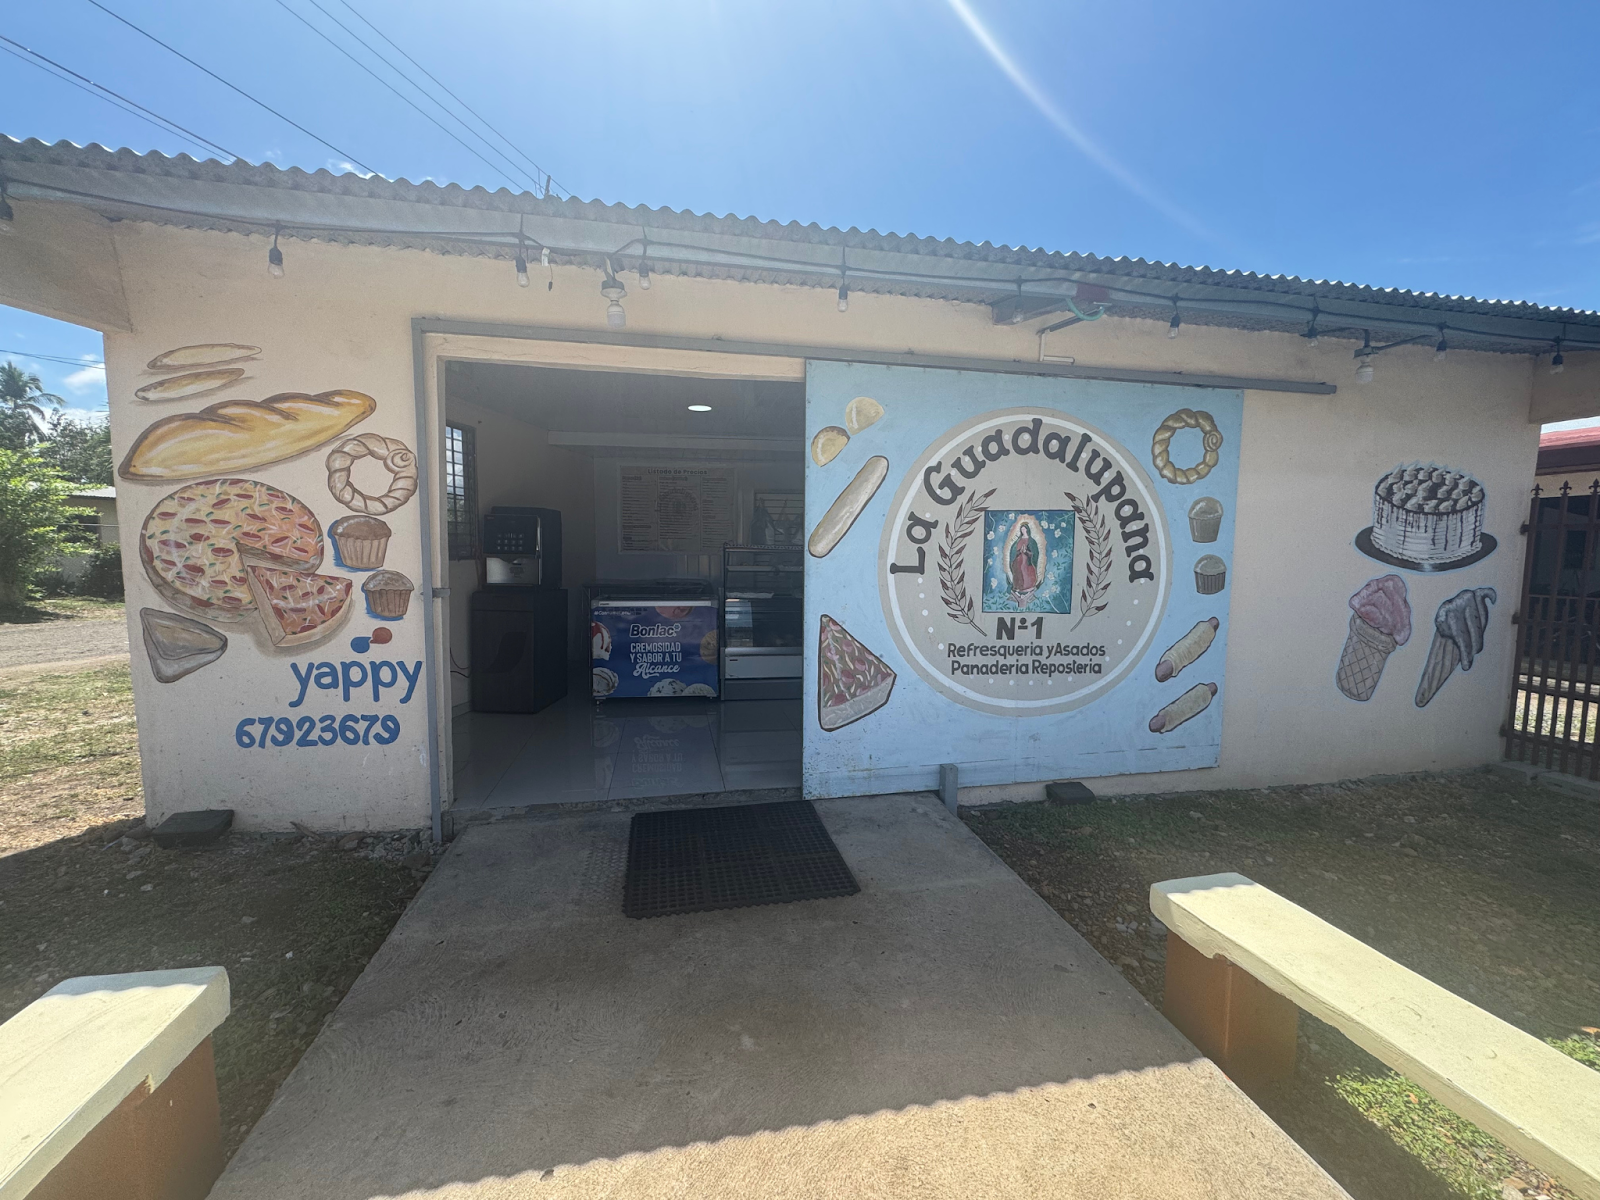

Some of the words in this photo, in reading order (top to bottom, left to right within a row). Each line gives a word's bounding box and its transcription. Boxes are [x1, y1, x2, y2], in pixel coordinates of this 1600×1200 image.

[890, 511, 939, 575] La
[923, 418, 1154, 583] Guadalupana
[629, 623, 677, 638] Bonlac
[630, 642, 681, 653] CREMOSIDAD
[947, 642, 1043, 659] Refresqueria
[629, 654, 636, 663] Y
[637, 653, 663, 663] SABOR
[664, 653, 671, 662] A
[672, 652, 682, 662] TU
[633, 662, 681, 679] Alcance
[951, 659, 1029, 675] Panaderia
[1031, 658, 1102, 677] Reposteria
[288, 660, 423, 708] yappy
[235, 713, 400, 749] 67923679
